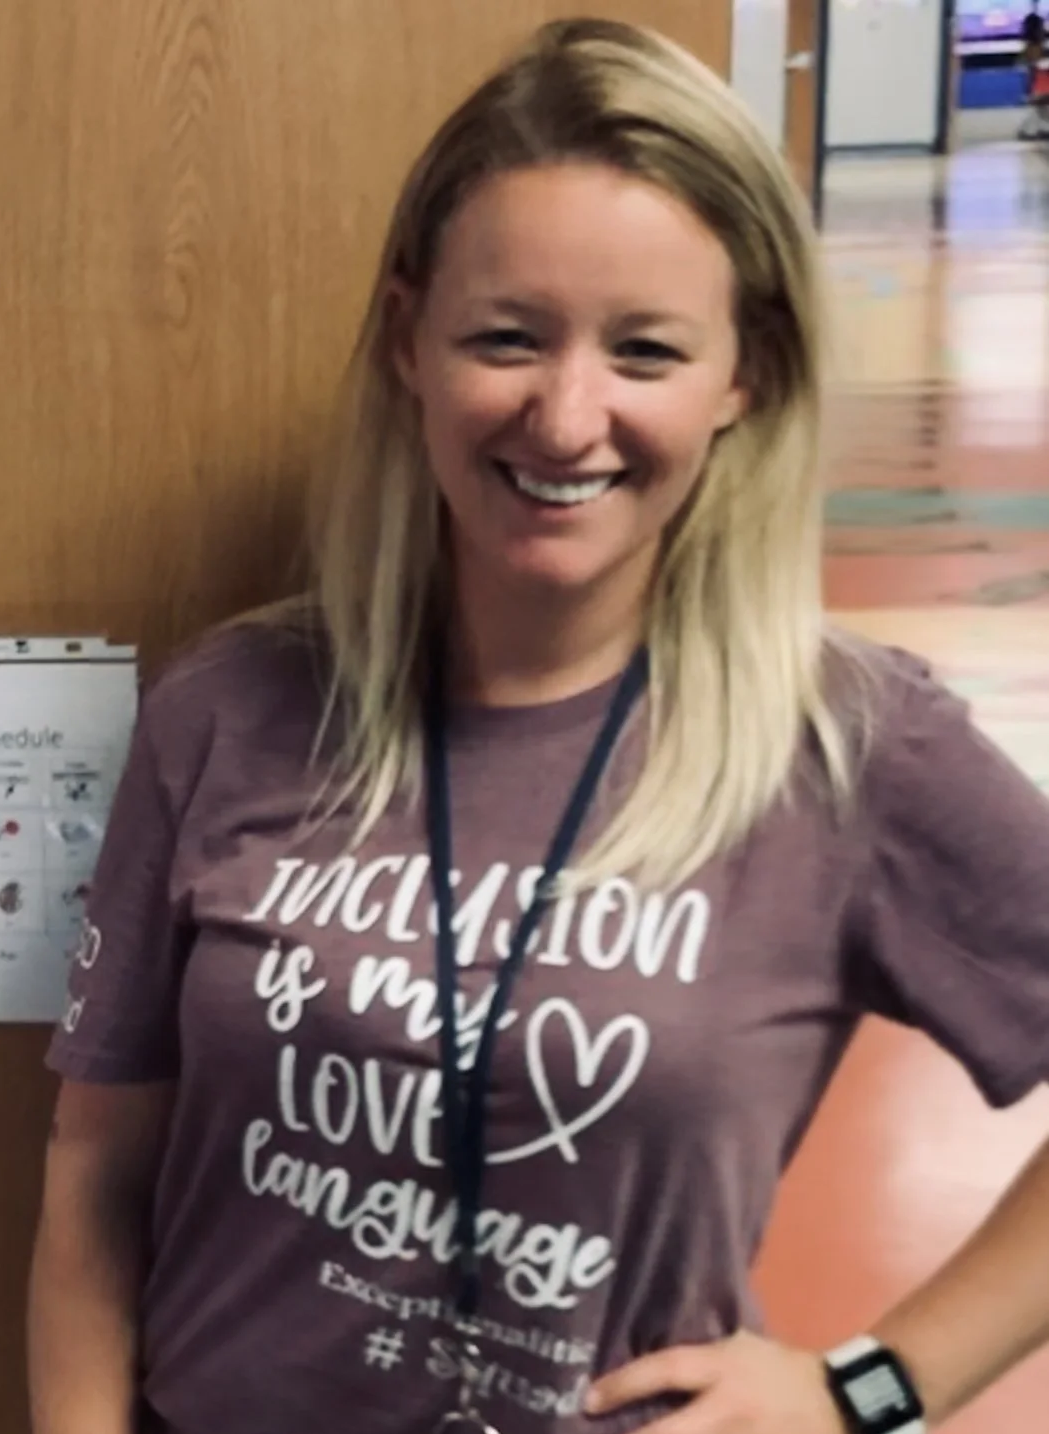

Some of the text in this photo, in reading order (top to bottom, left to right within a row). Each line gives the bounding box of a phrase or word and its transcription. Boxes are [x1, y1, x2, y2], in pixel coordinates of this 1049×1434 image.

[255, 940, 521, 1073] is my
[278, 1044, 445, 1168] LOVE
[241, 1118, 618, 1310] language
